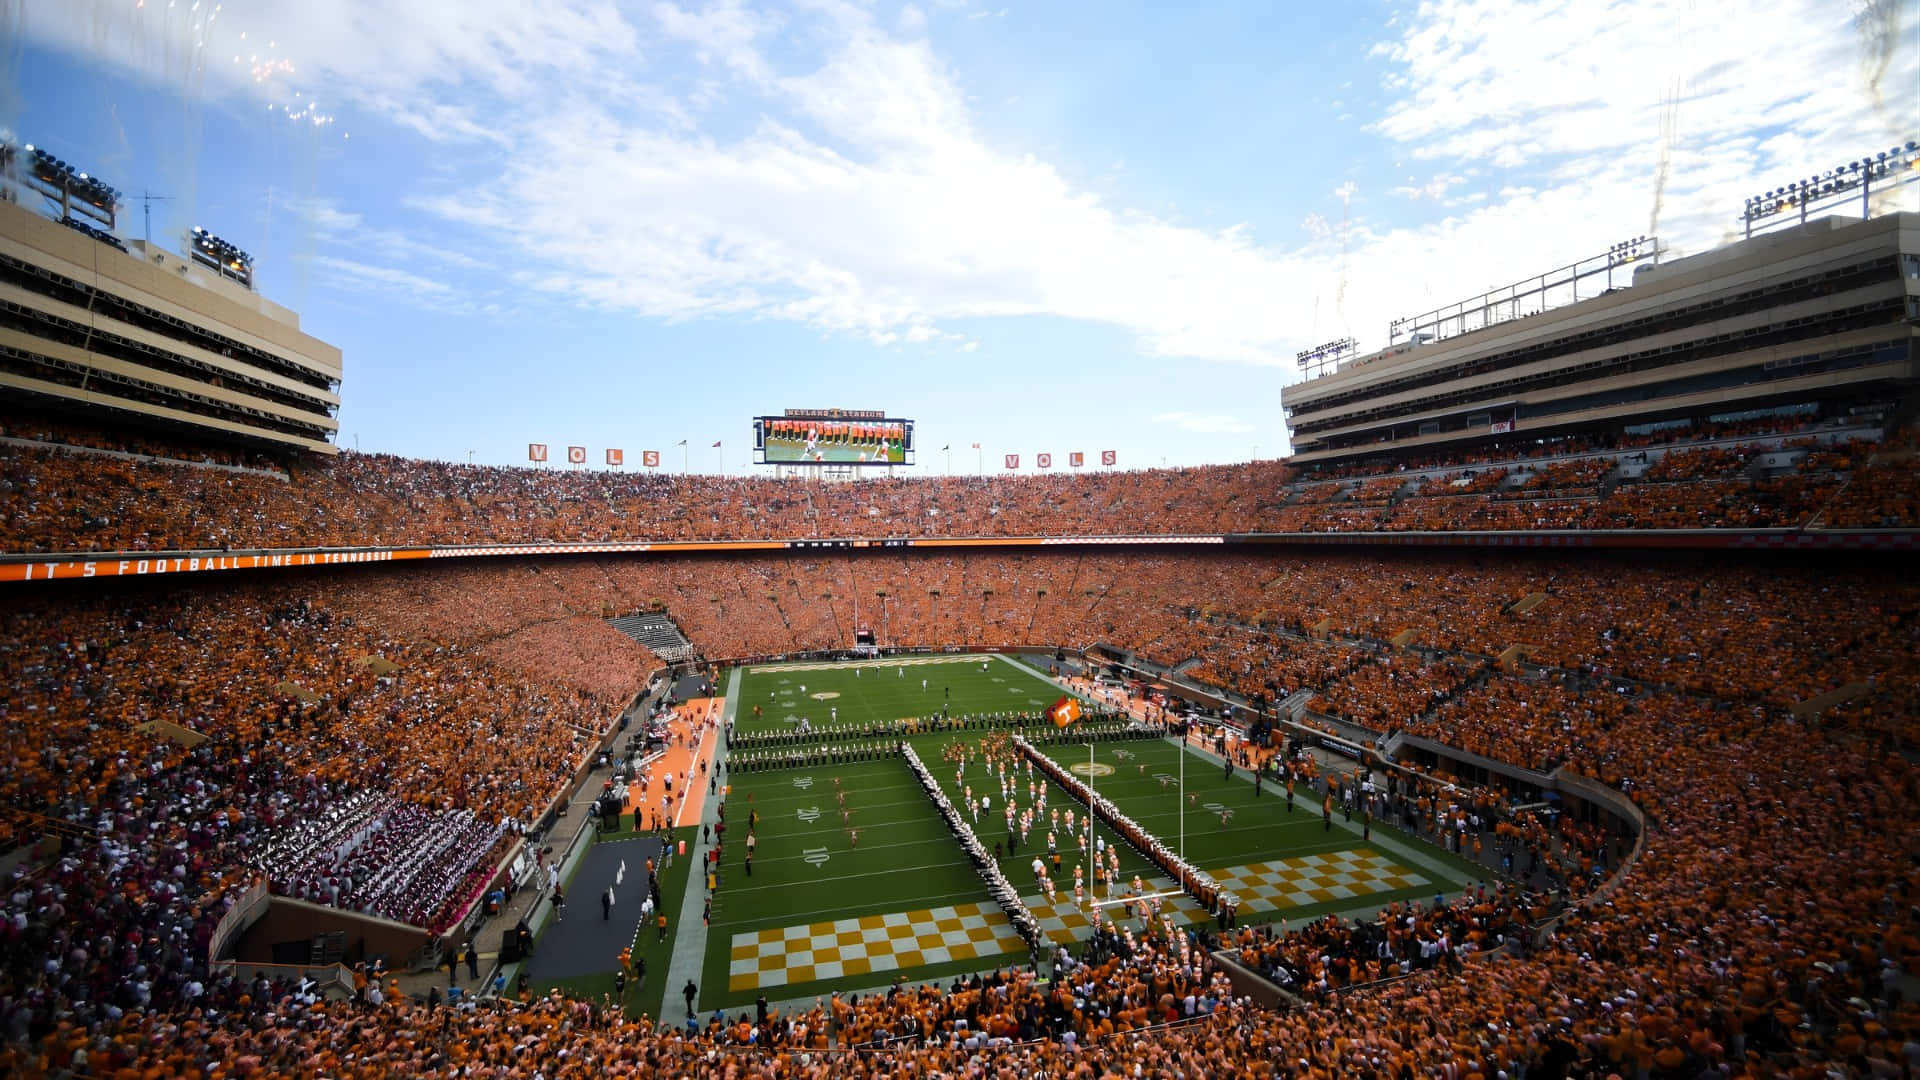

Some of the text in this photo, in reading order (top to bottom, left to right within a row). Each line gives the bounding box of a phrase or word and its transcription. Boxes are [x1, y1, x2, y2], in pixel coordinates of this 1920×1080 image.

[25, 551, 393, 580] IT'S FOOTBALL TIME IN TENNESSEE
[1057, 704, 1072, 723] T
[802, 846, 830, 864] 10
